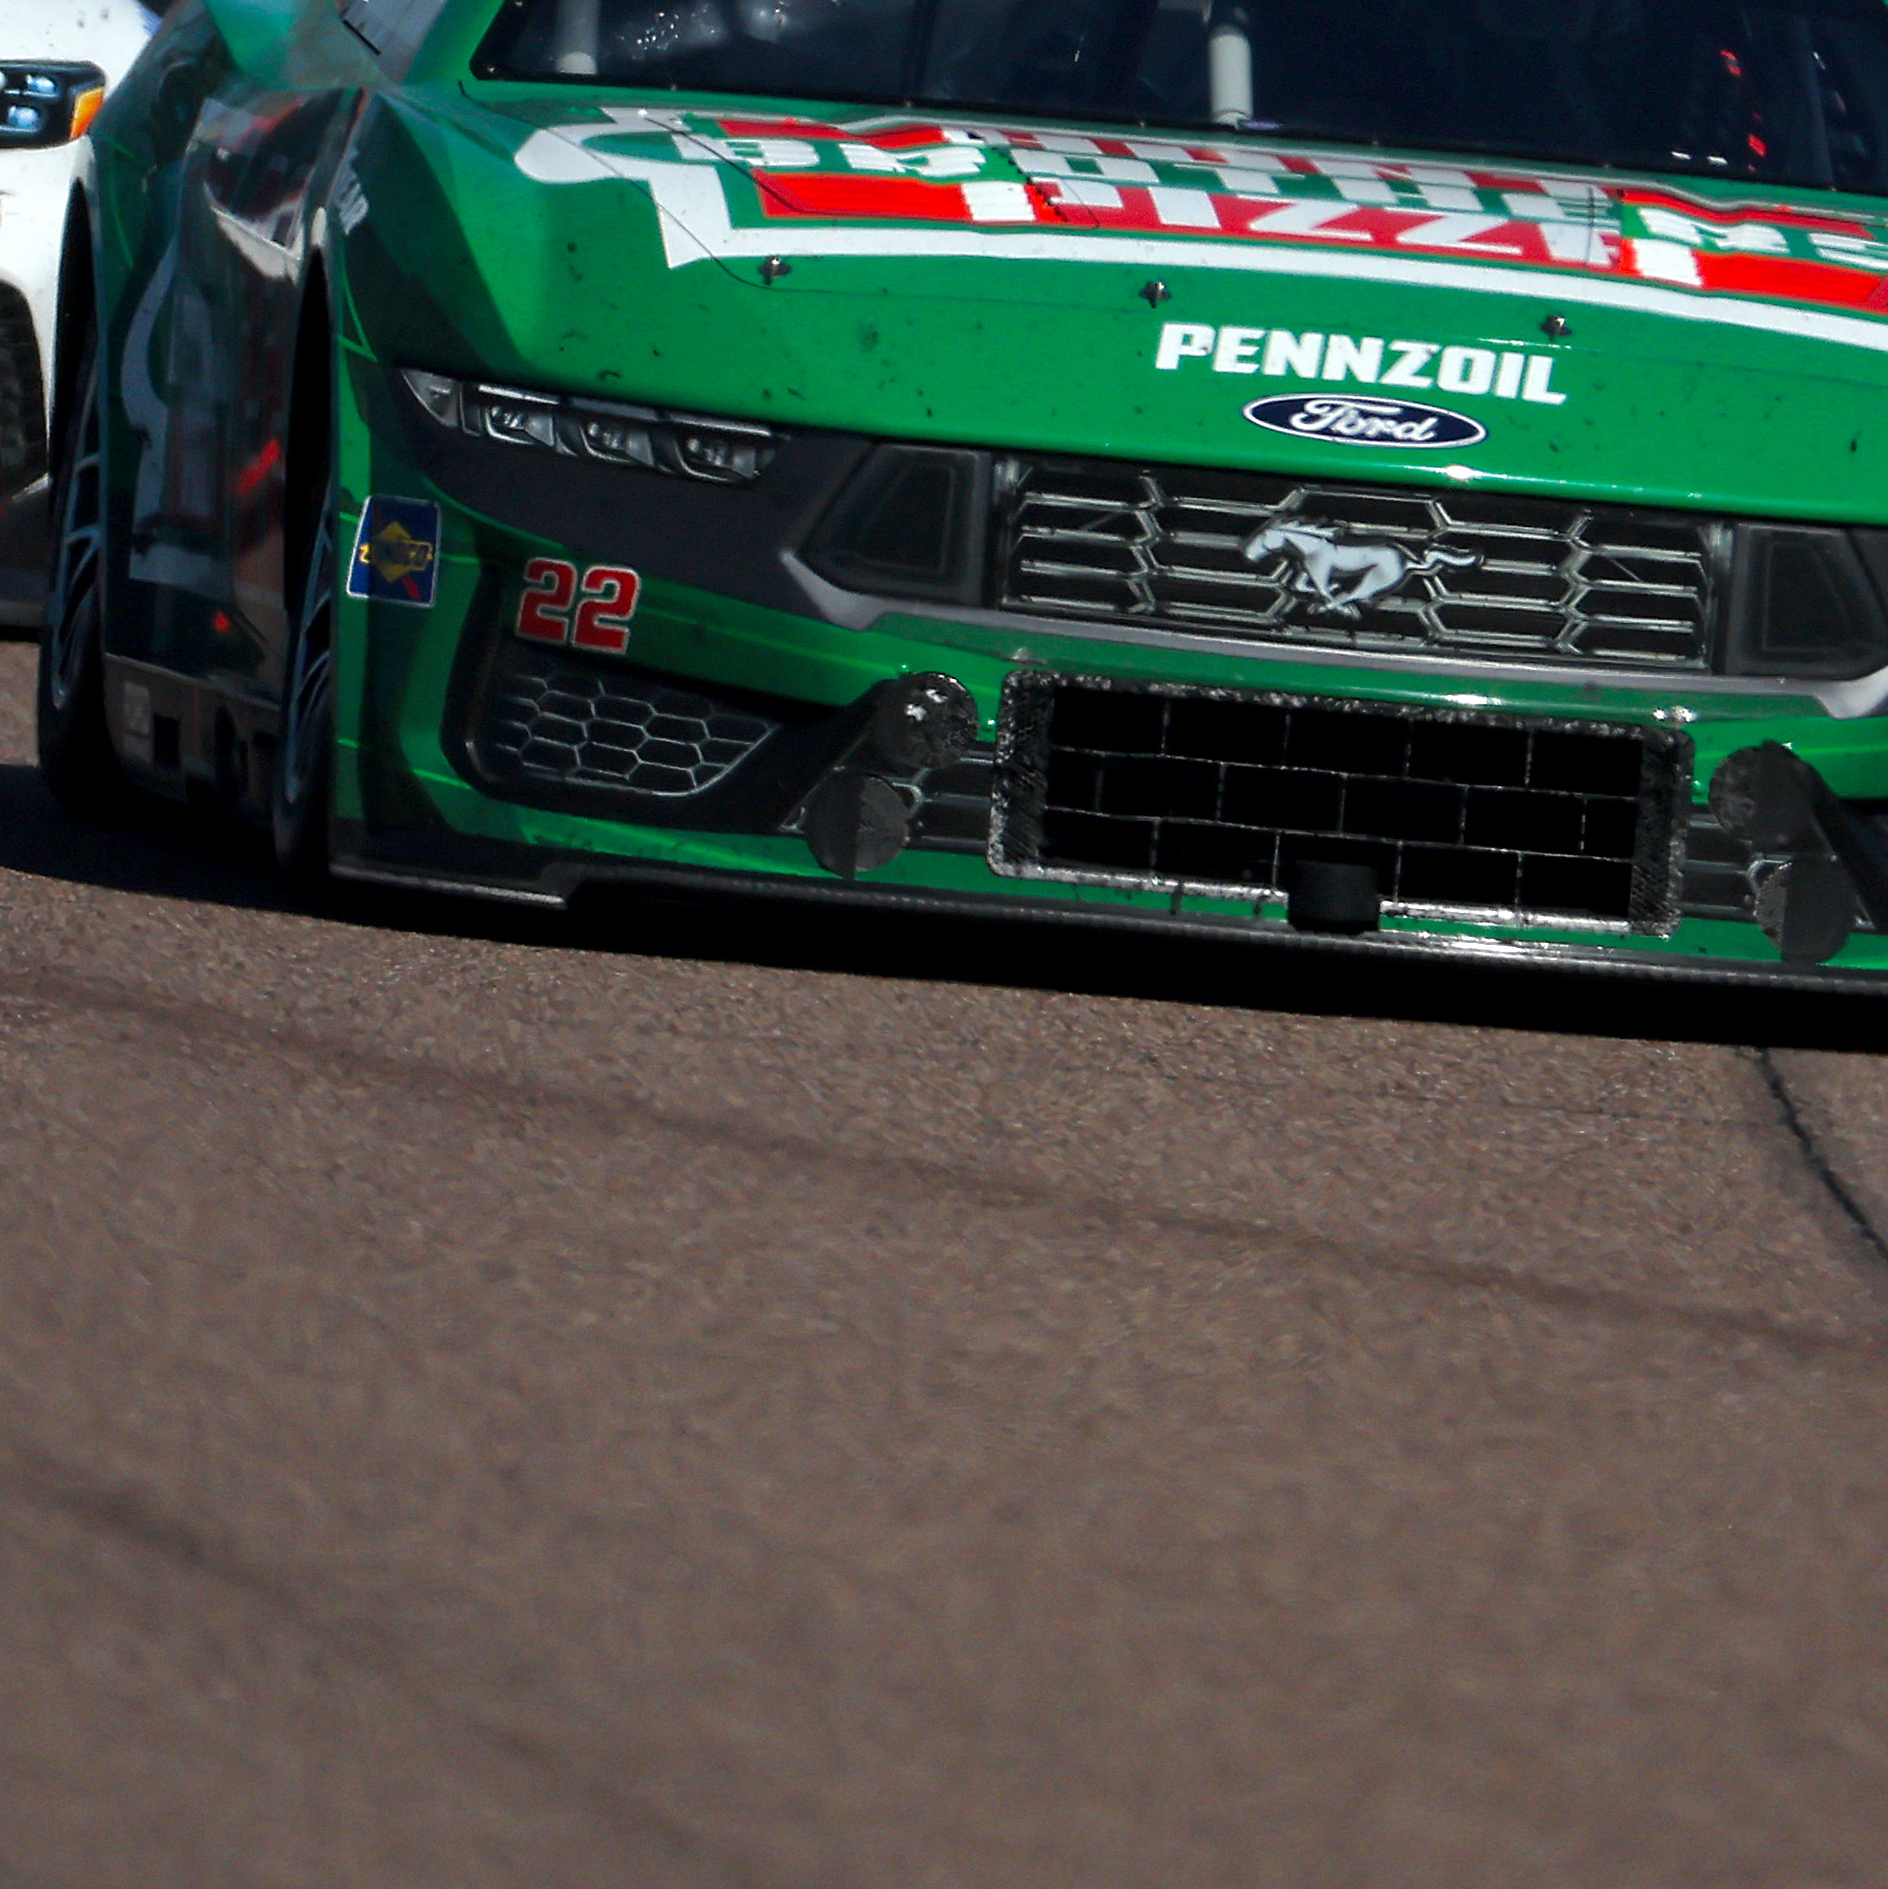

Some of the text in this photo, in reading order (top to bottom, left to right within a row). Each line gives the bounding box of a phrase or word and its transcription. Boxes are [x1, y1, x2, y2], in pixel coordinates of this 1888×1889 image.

[1155, 321, 1567, 406] PENNZOIL
[1289, 397, 1446, 445] Ford
[514, 555, 642, 655] 22
